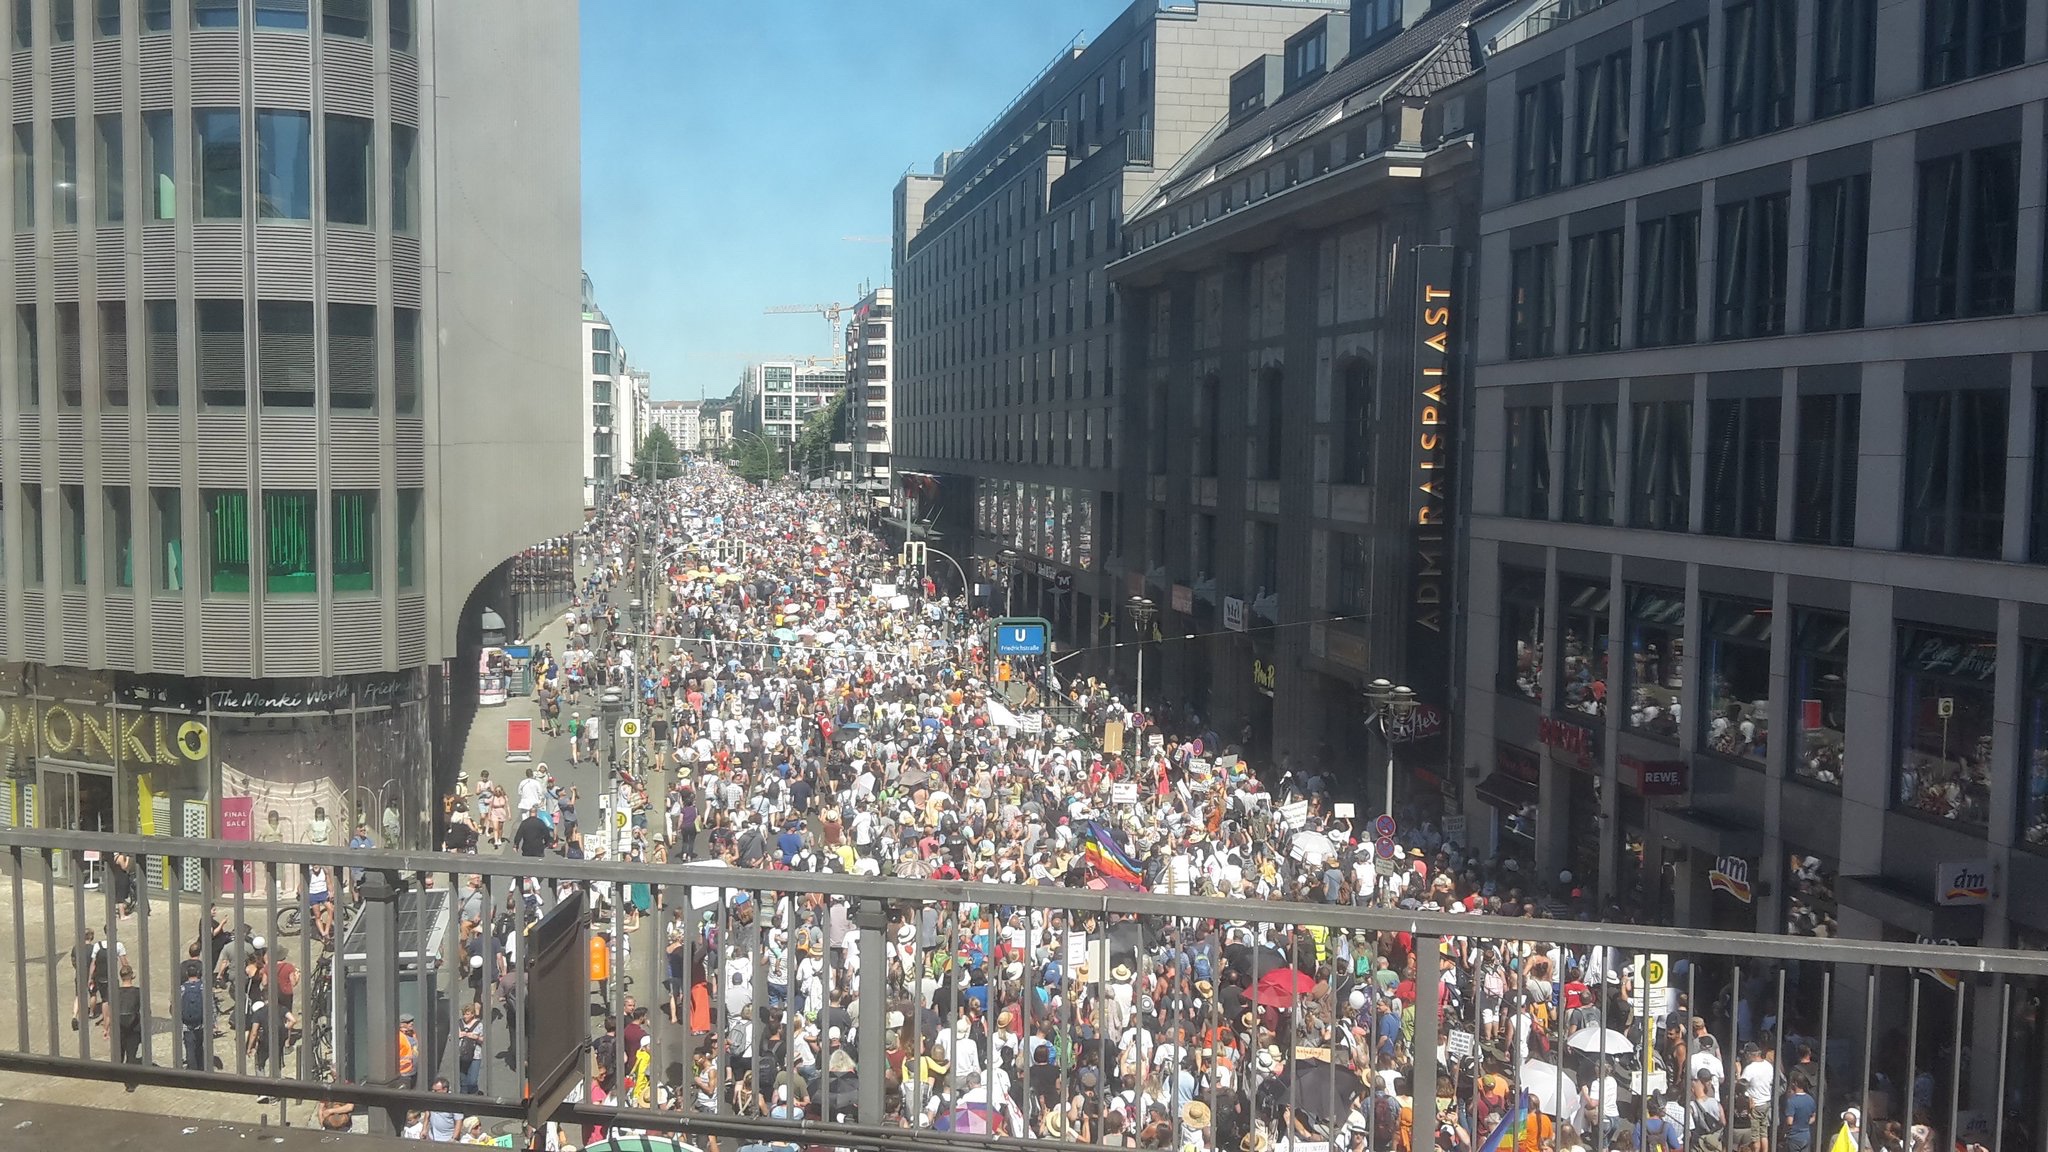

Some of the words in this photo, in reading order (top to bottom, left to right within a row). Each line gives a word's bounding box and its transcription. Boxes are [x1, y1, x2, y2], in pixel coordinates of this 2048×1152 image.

[1416, 285, 1451, 632] ADMIRALSPALAST
[1015, 629, 1027, 643] U
[210, 689, 239, 707] The
[241, 692, 302, 708] Monki
[306, 682, 348, 706] World
[1645, 772, 1678, 783] REWE
[1953, 868, 1984, 888] dm
